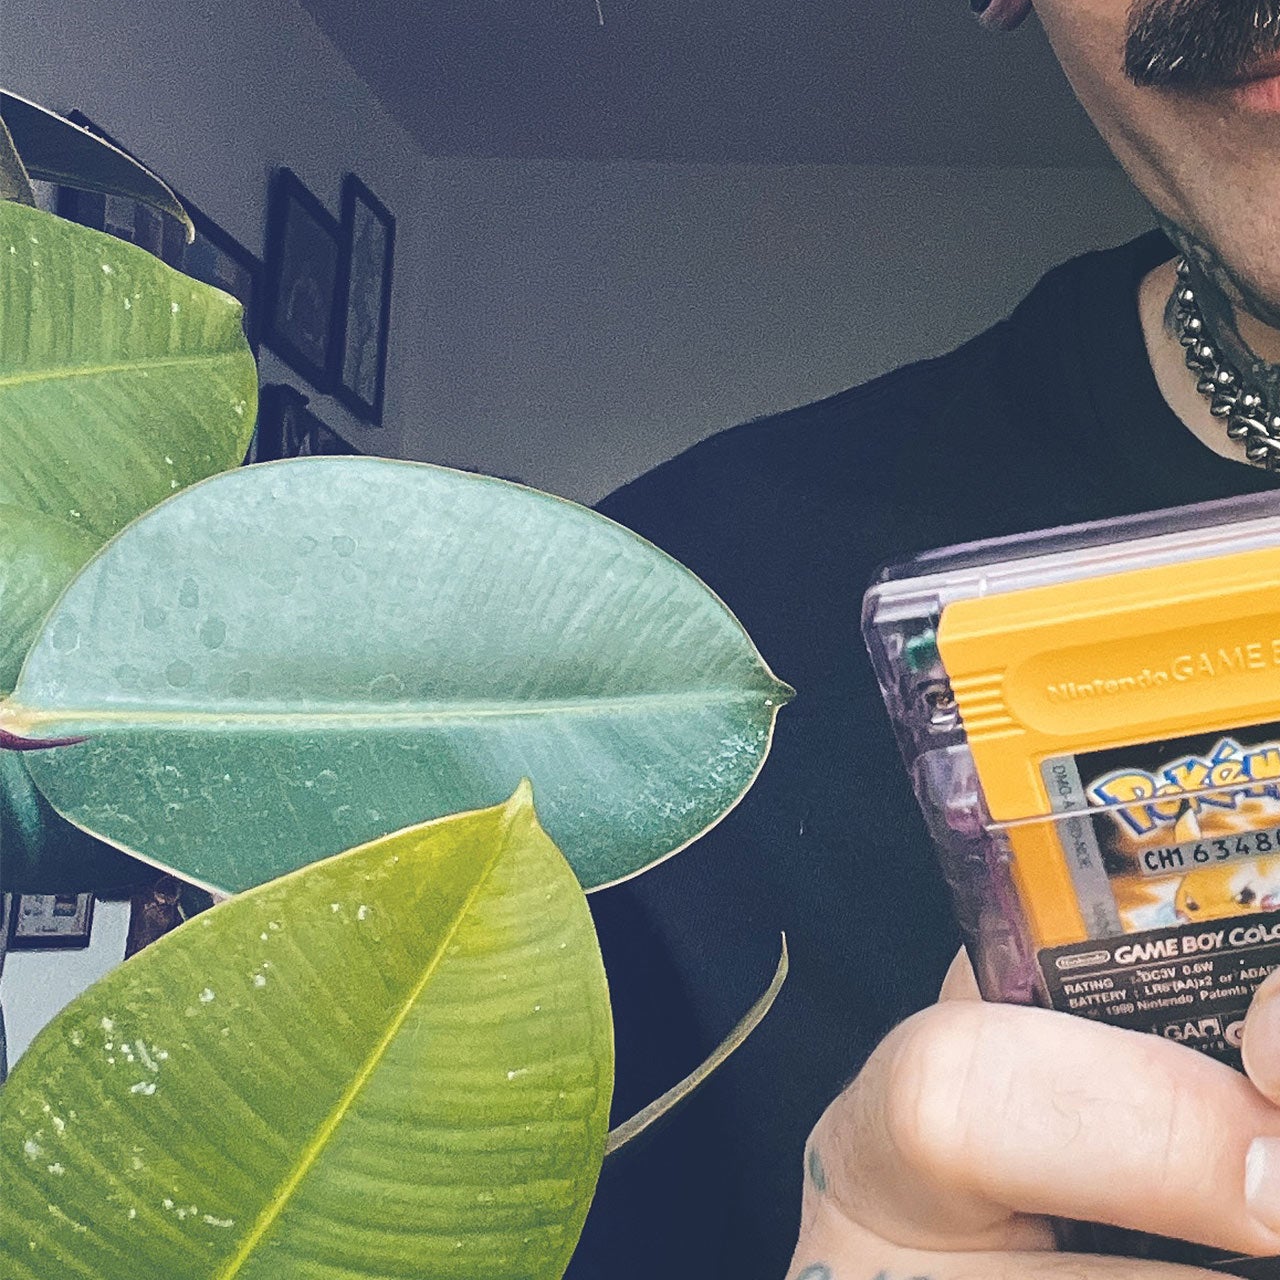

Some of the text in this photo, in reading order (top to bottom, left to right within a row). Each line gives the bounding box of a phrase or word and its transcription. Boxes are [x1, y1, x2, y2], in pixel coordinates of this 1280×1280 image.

[1045, 667, 1169, 704] Nintendo
[1171, 643, 1267, 683] GAME
[1114, 937, 1179, 965] GAME
[1182, 929, 1225, 954] BOY
[1063, 977, 1115, 995] RATING
[1068, 988, 1127, 1009] BATTERY
[1136, 992, 1194, 1010] Nintendo
[1199, 985, 1248, 1001] Patents
